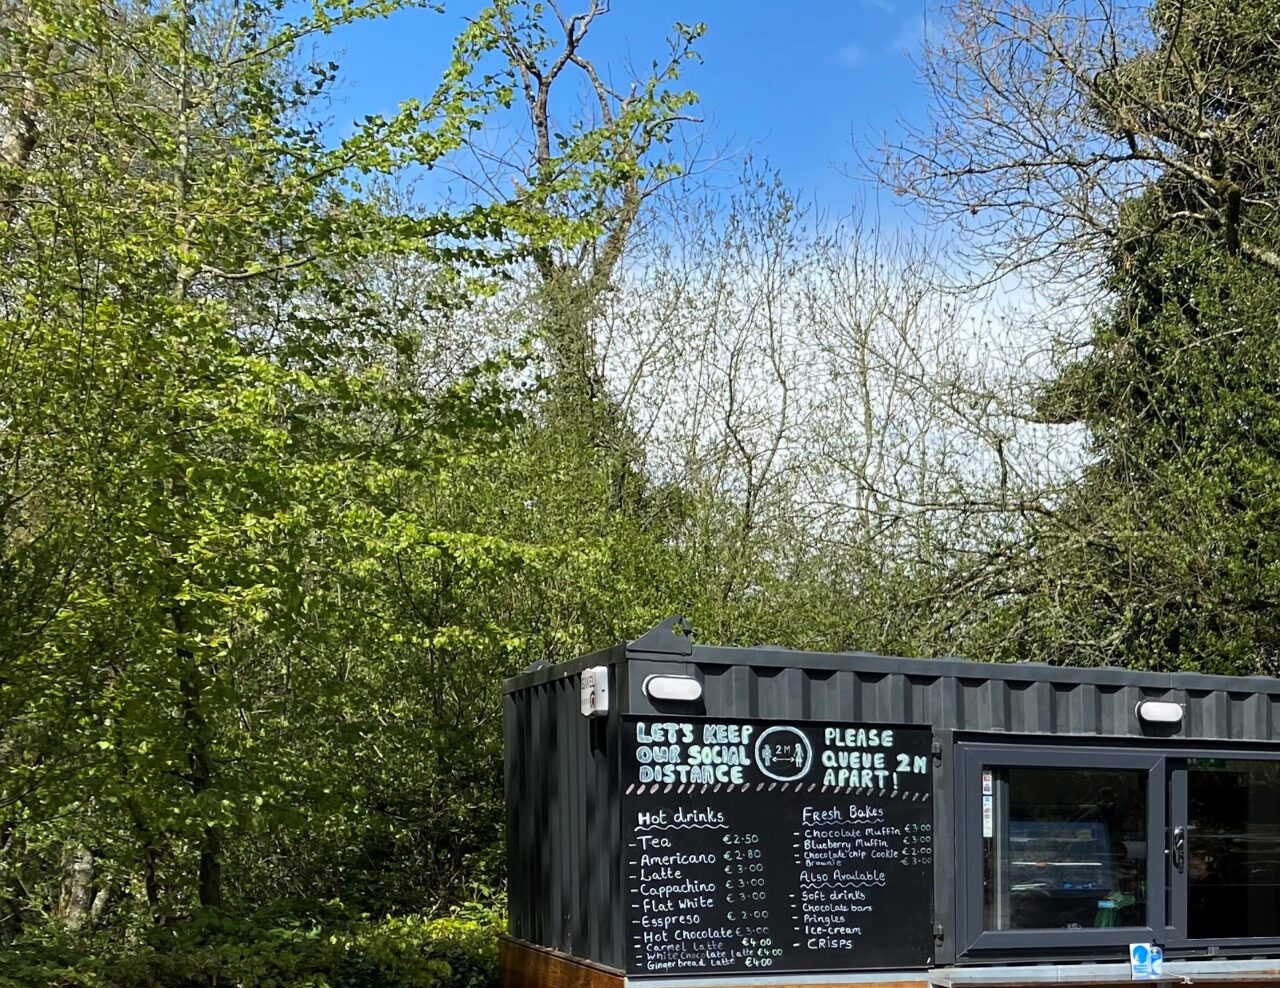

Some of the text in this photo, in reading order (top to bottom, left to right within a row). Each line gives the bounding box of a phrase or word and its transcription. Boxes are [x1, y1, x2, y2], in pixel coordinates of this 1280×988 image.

[636, 722, 753, 744] LET'S KEEP
[824, 727, 894, 747] PLEASE
[636, 744, 750, 765] OUR SOCIAL
[821, 750, 886, 769] QUEUE
[639, 764, 745, 784] DISTANCE
[638, 806, 724, 825] Hot drinks
[849, 804, 884, 818] Bakes
[804, 829, 861, 838] Chocolate
[865, 826, 901, 837] Muffin
[636, 835, 672, 850] Tea
[804, 839, 852, 853] Blueberry
[855, 839, 889, 848] Muffin
[640, 852, 716, 867] Americano
[871, 849, 899, 858] Cookie
[805, 859, 842, 867] Brownie
[640, 867, 683, 881] Latte
[800, 869, 886, 882] Also Available
[640, 879, 716, 898] Cappachino
[801, 890, 866, 901] Soft drinks
[678, 896, 714, 909] White
[802, 903, 873, 912] Chocolate bars
[641, 914, 700, 929] Esspreso
[804, 914, 846, 926] Pringles
[643, 930, 668, 944] Hot
[674, 926, 734, 940] Chocolate
[805, 925, 862, 935] Ice-cream
[646, 941, 687, 952] Carmel
